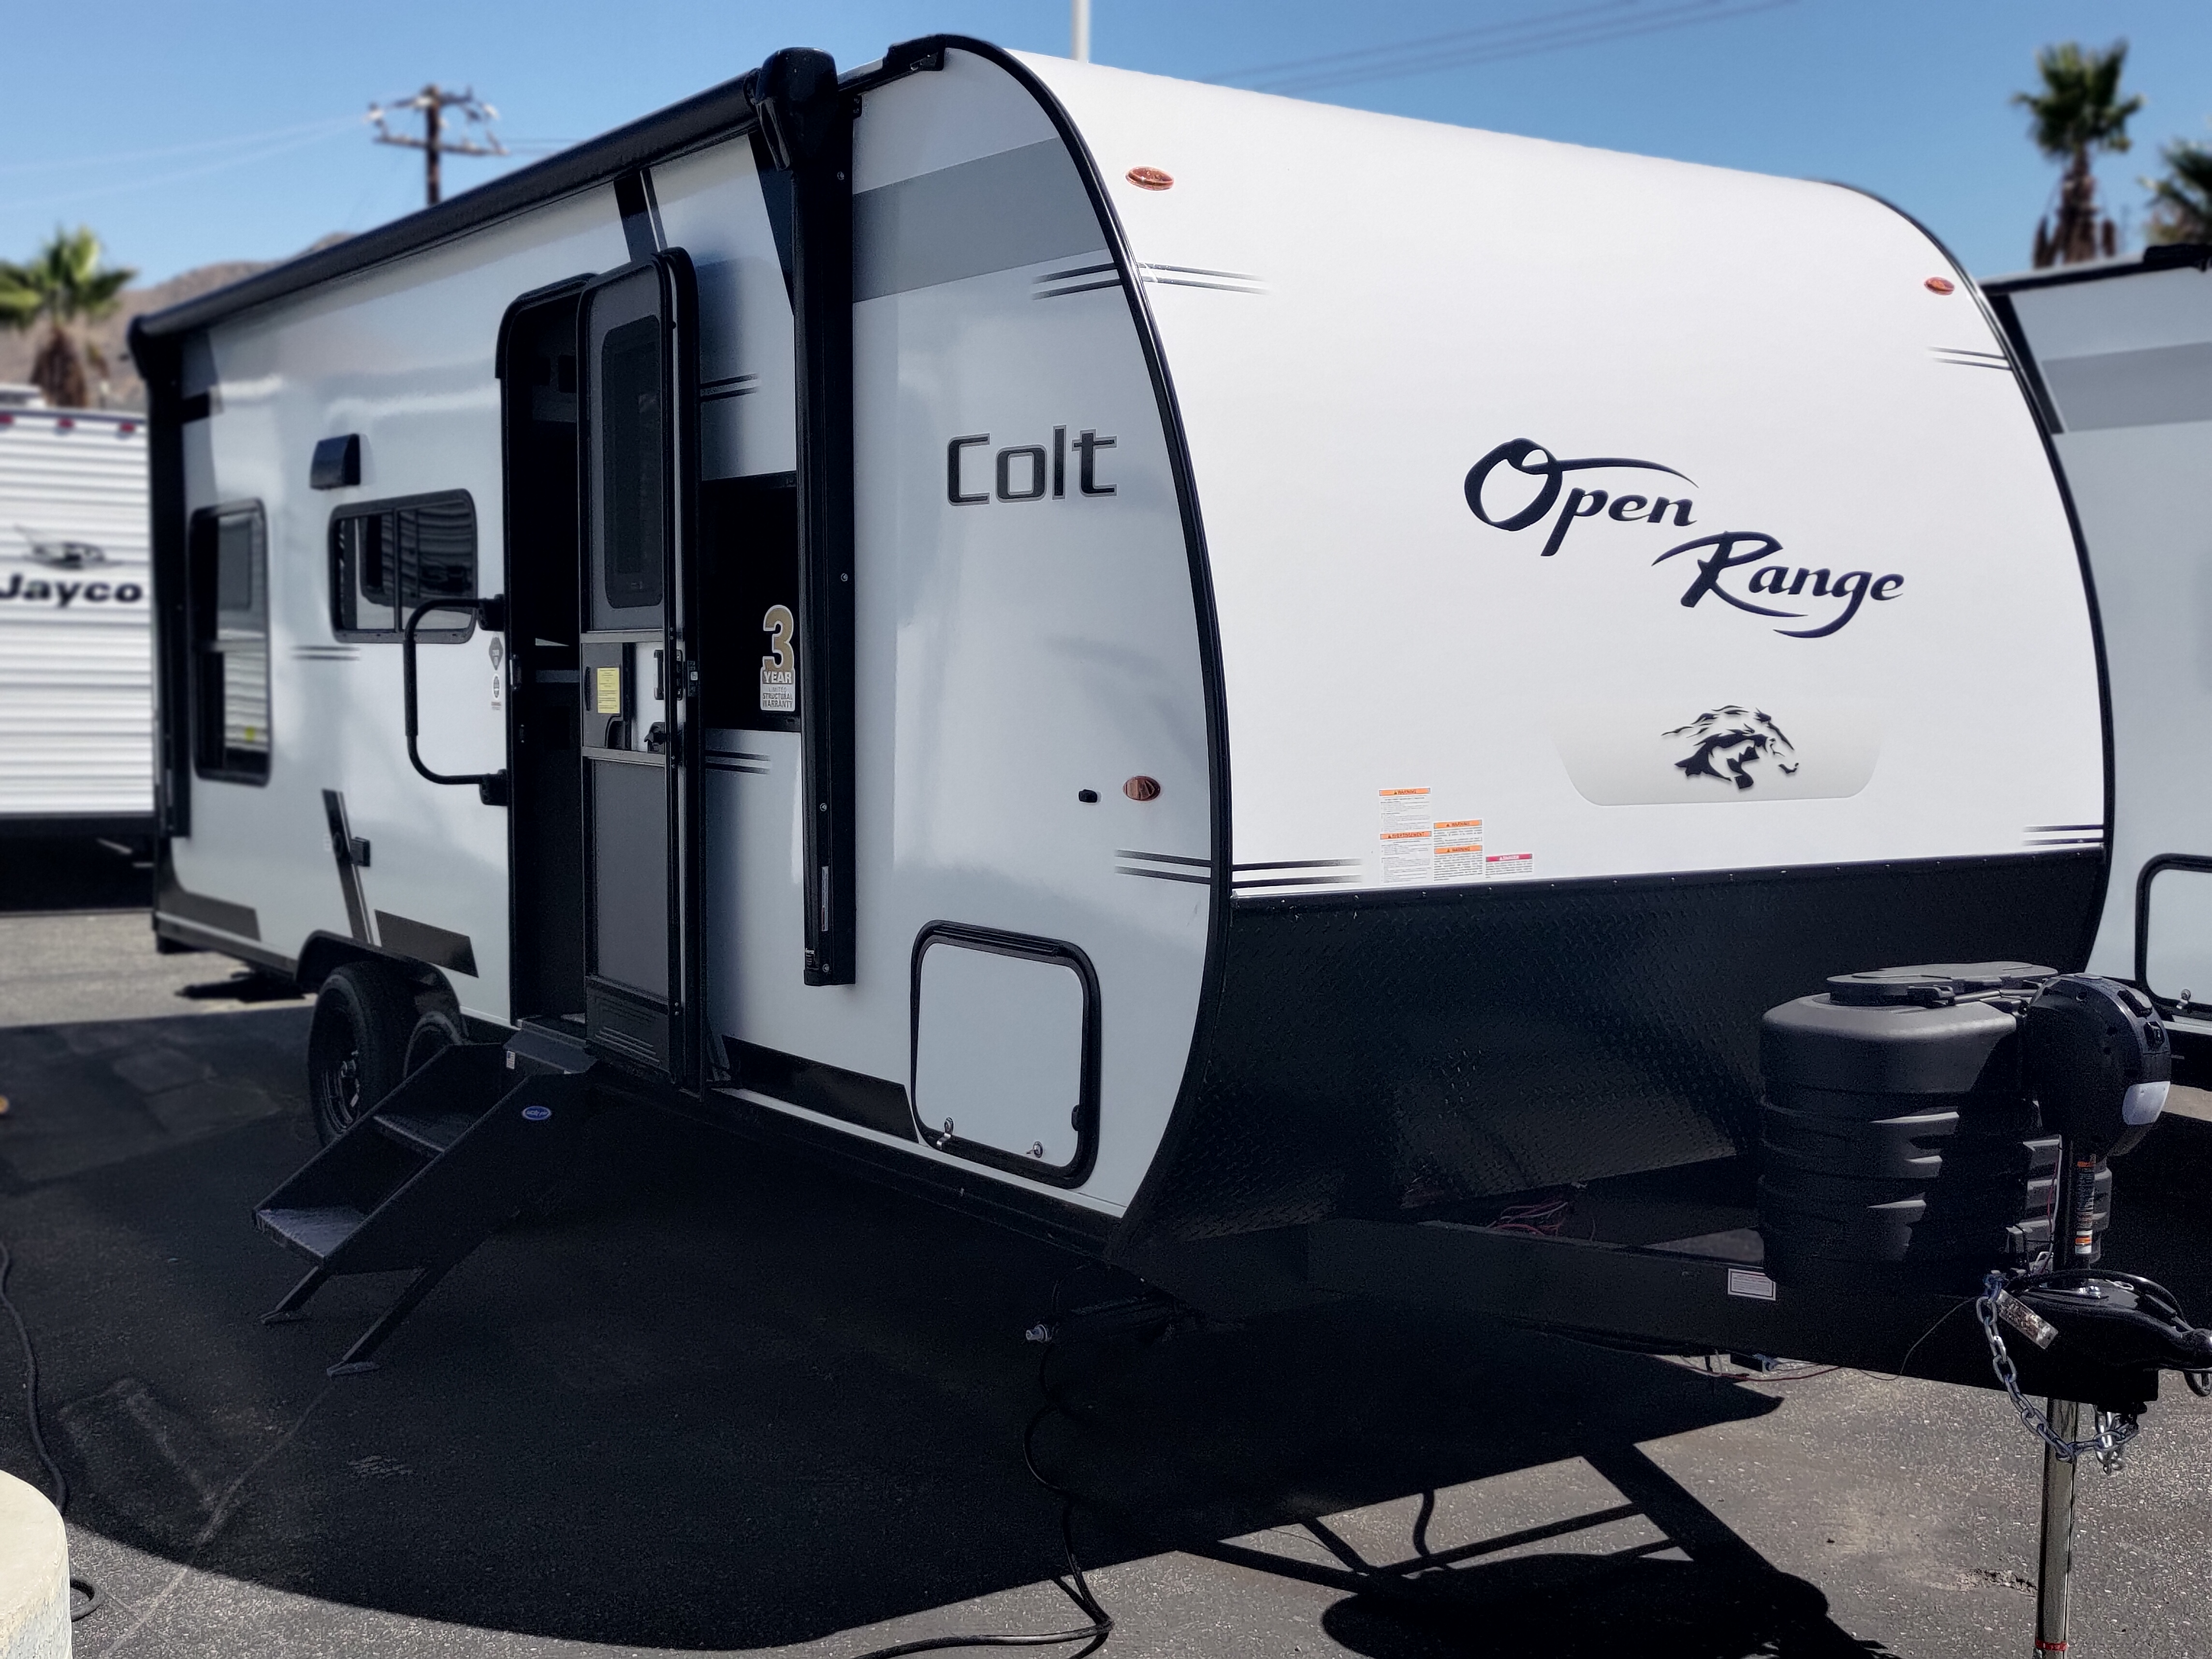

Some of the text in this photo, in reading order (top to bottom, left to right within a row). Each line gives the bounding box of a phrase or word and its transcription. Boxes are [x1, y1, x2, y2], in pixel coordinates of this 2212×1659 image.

[947, 424, 1118, 506] Colt
[1464, 437, 1700, 556] Open
[0, 574, 143, 608] Jayco
[1651, 531, 1905, 639] Range
[762, 604, 794, 671] 3
[762, 699, 793, 708] WARRANTY
[763, 671, 792, 684] YEAR
